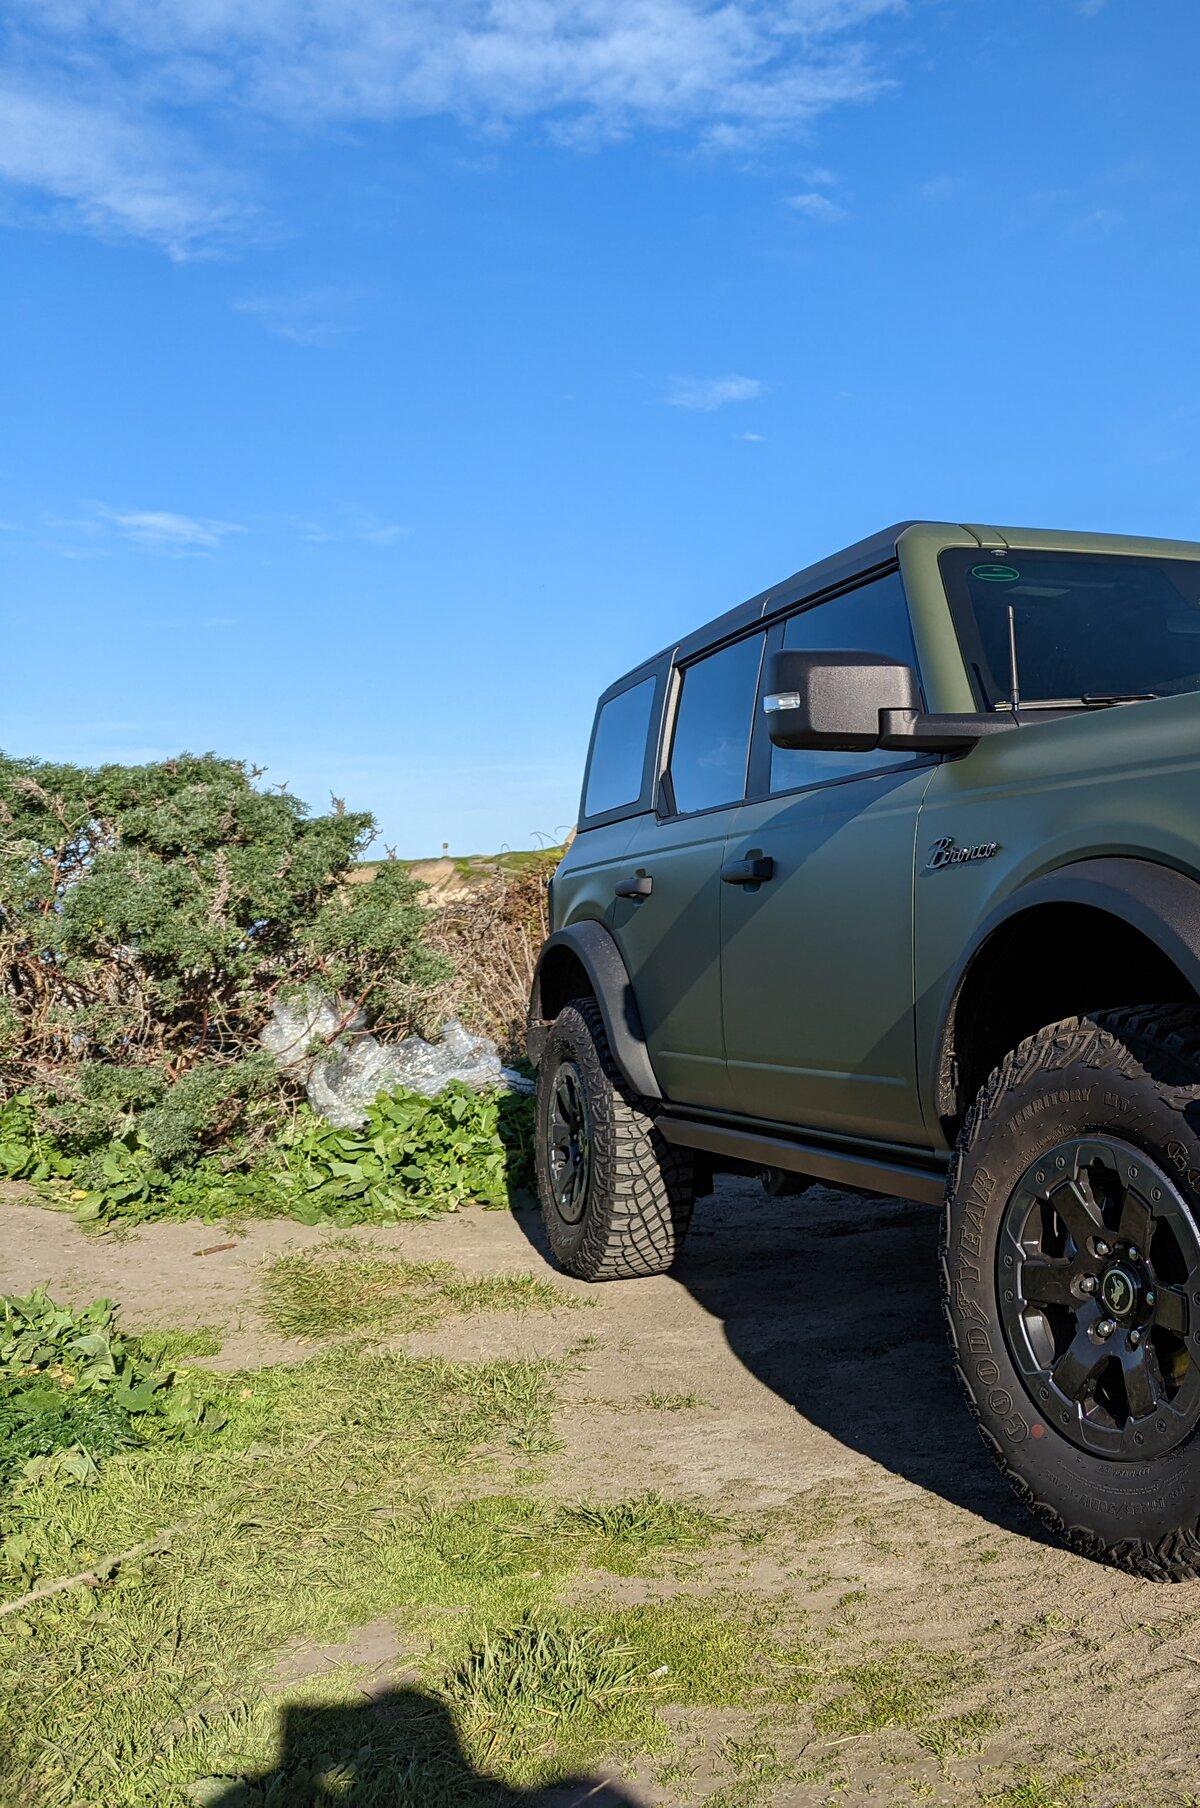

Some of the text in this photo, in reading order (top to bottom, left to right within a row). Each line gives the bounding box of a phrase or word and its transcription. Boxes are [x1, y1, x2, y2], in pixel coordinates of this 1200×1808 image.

[926, 836, 999, 869] Bronco
[1006, 1088, 1092, 1134] TERRITORY
[955, 1167, 1029, 1443] GOODYEAR
